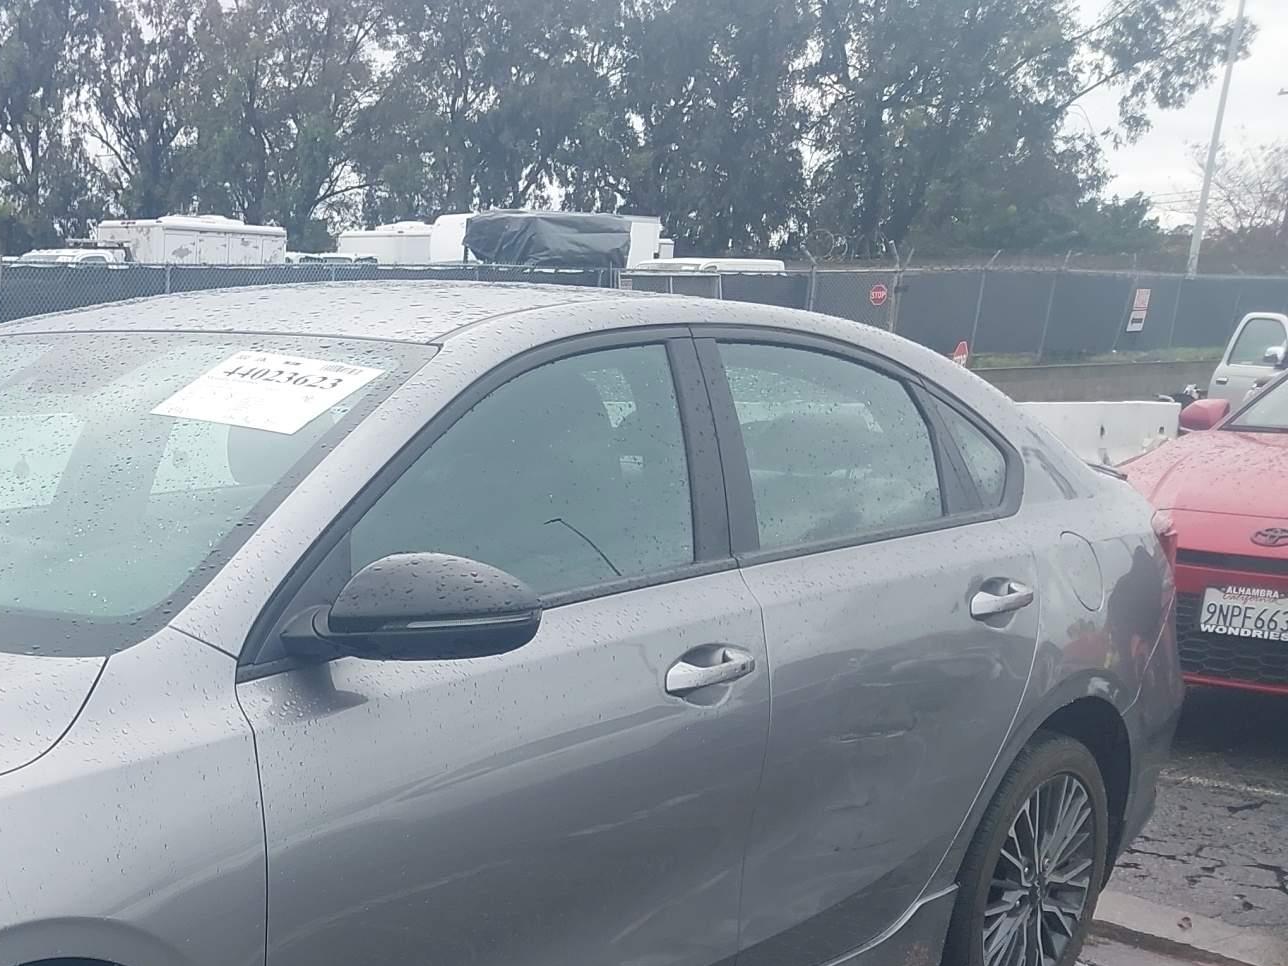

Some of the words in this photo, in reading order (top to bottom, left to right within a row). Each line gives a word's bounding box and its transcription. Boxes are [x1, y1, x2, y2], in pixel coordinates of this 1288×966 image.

[871, 291, 887, 299] STOP
[223, 364, 344, 390] 44023623
[1225, 586, 1279, 599] ALHAMBRA
[1200, 623, 1288, 641] WONDRIES
